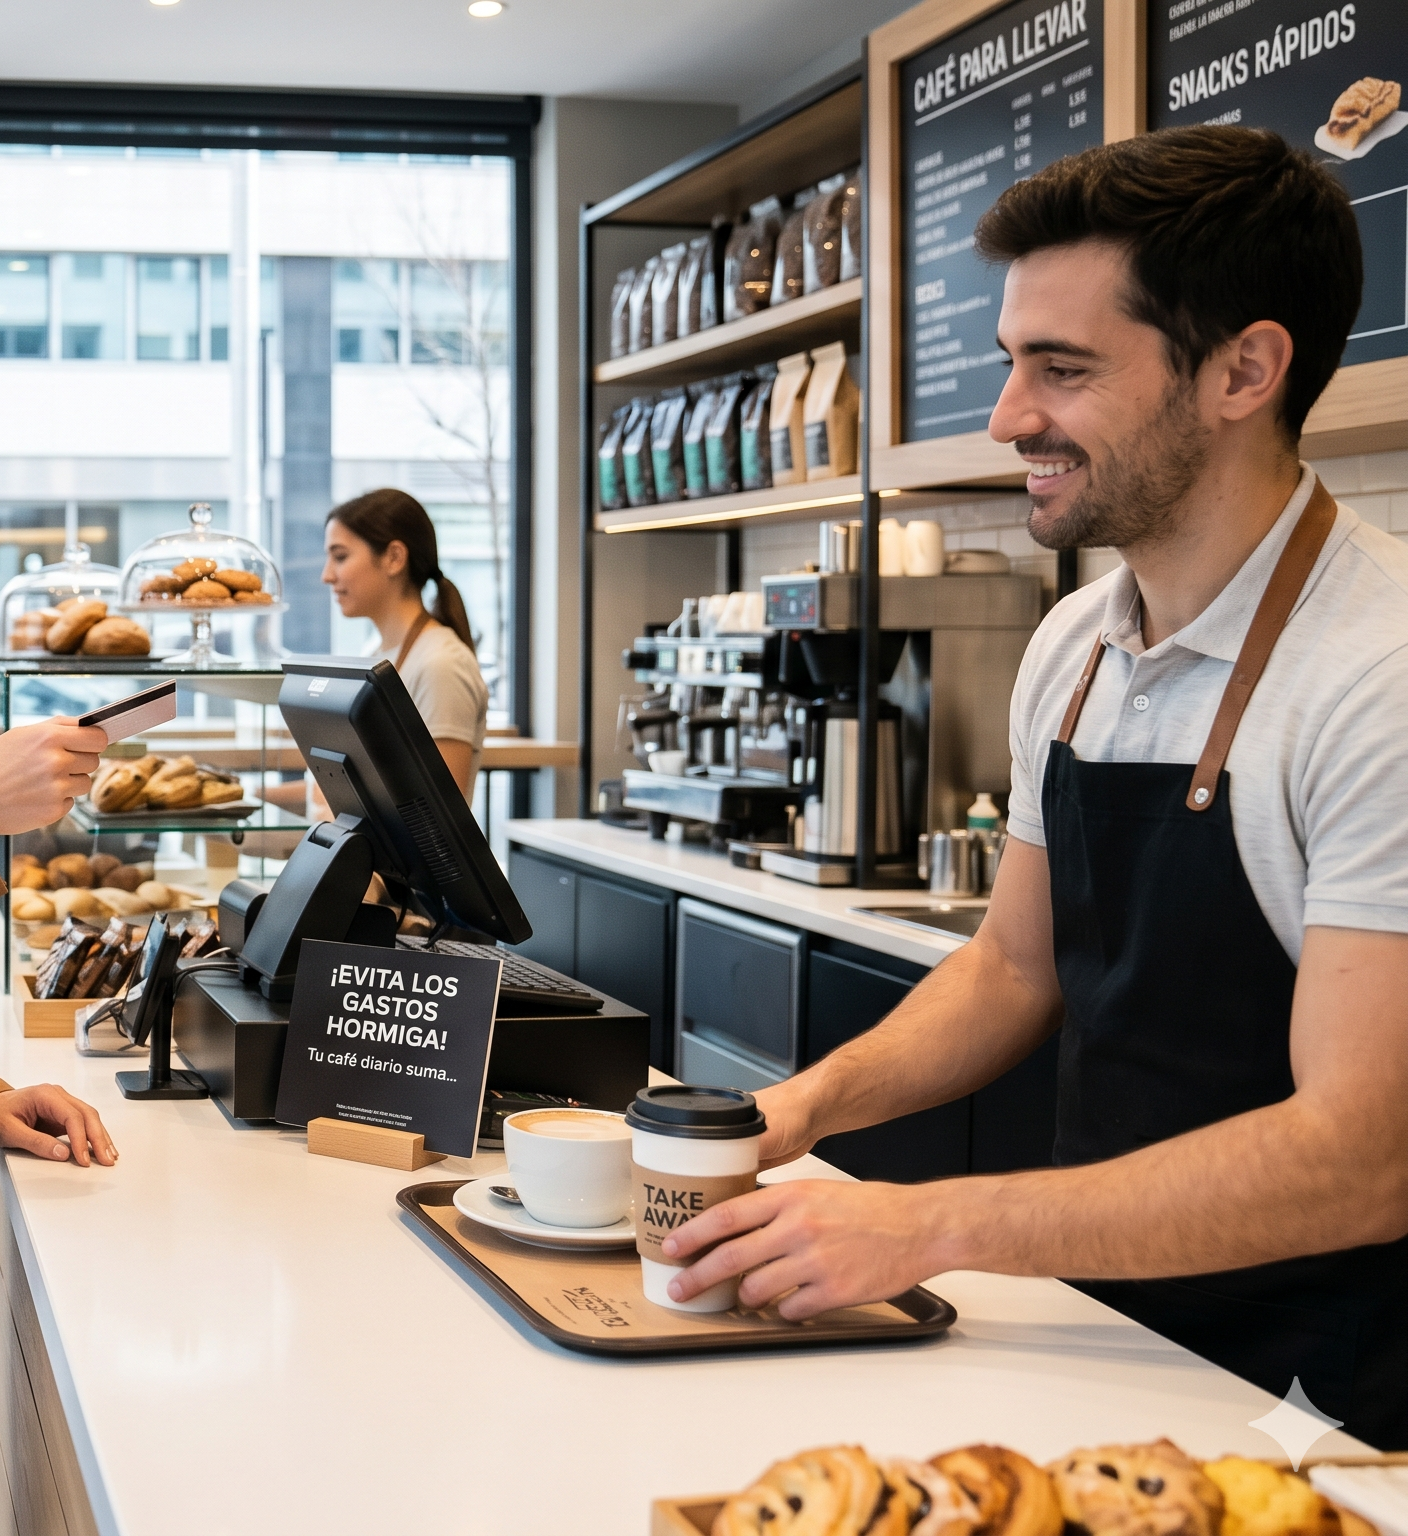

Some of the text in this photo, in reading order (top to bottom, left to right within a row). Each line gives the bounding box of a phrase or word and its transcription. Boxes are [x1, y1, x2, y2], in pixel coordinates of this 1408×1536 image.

[914, 0, 1087, 113] CAFÉ PARA LLEVAR
[1168, 3, 1356, 111] SNACKS RÁPIDOS
[331, 964, 459, 997] ¡EVITA LOS
[342, 991, 439, 1022] GASTOS
[326, 1015, 448, 1051] HORMIGA!
[307, 1047, 457, 1082] Tu café diario suma...
[643, 1183, 704, 1211] TAKE
[643, 1206, 698, 1229] AWA
